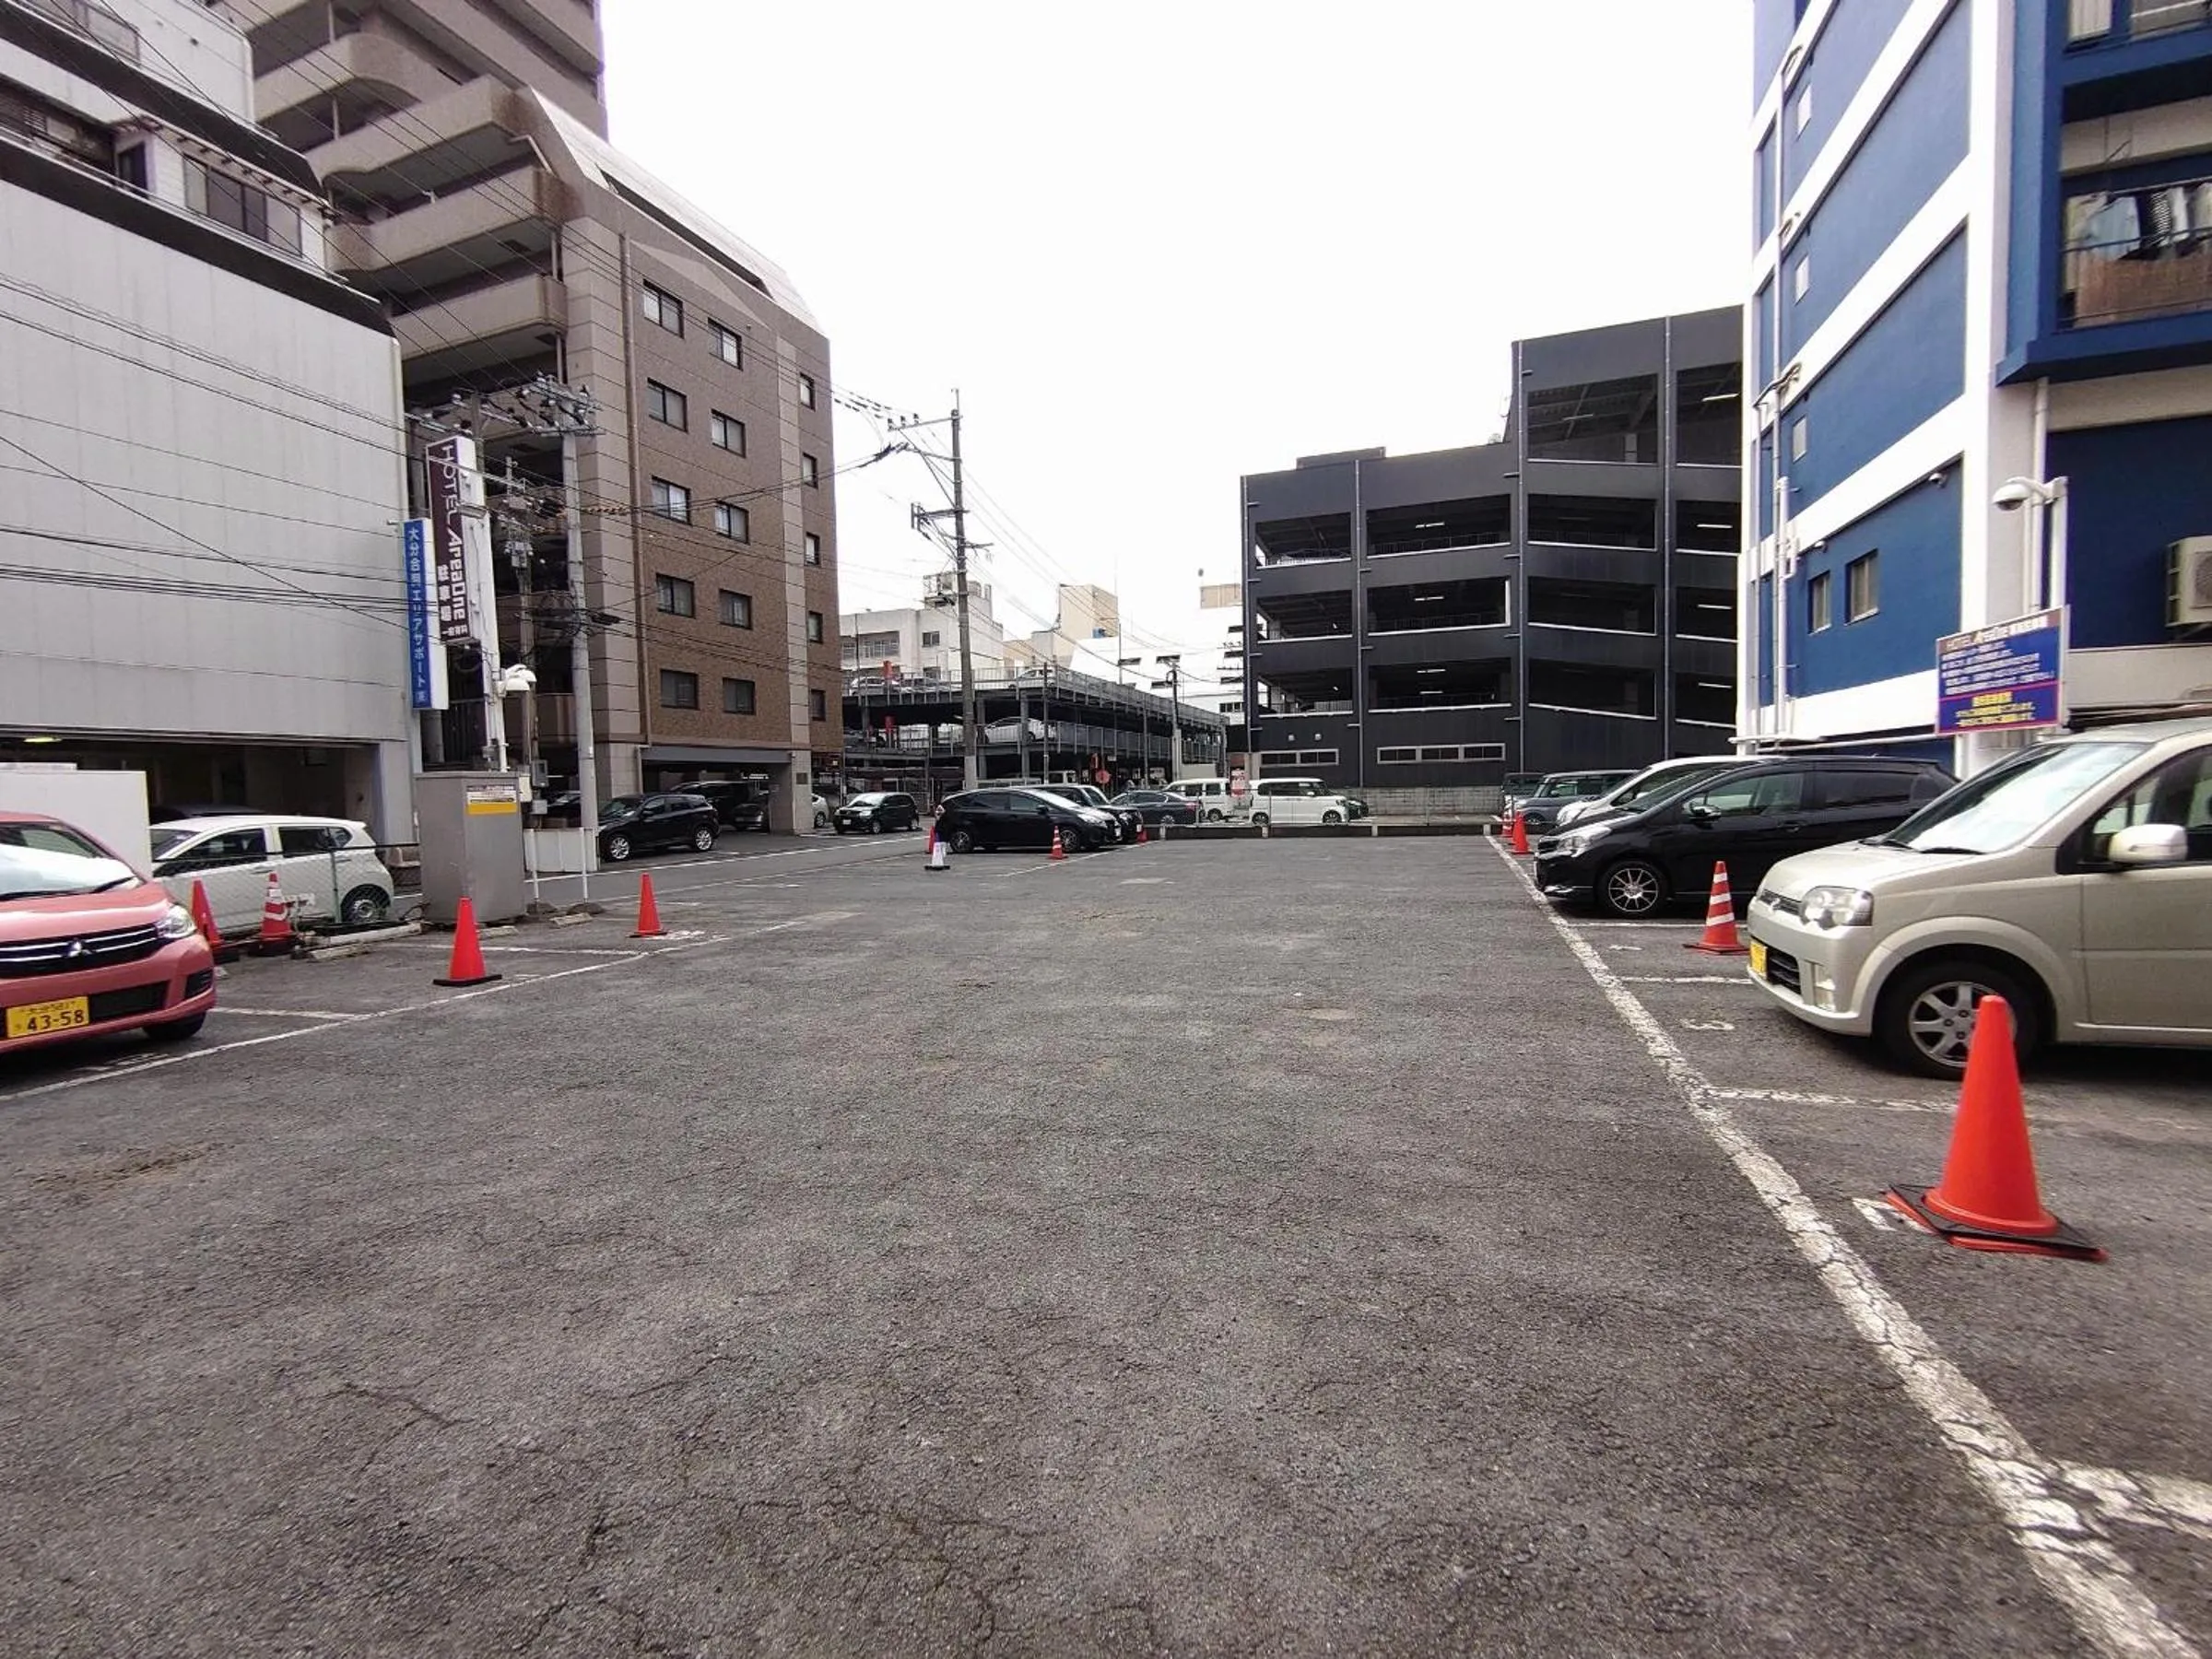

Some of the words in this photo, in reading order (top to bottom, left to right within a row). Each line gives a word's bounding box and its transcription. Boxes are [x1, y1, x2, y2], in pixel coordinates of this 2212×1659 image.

[441, 445, 459, 525] HOTEL
[446, 526, 467, 620] AreaOne
[27, 1009, 85, 1030] 43-58
